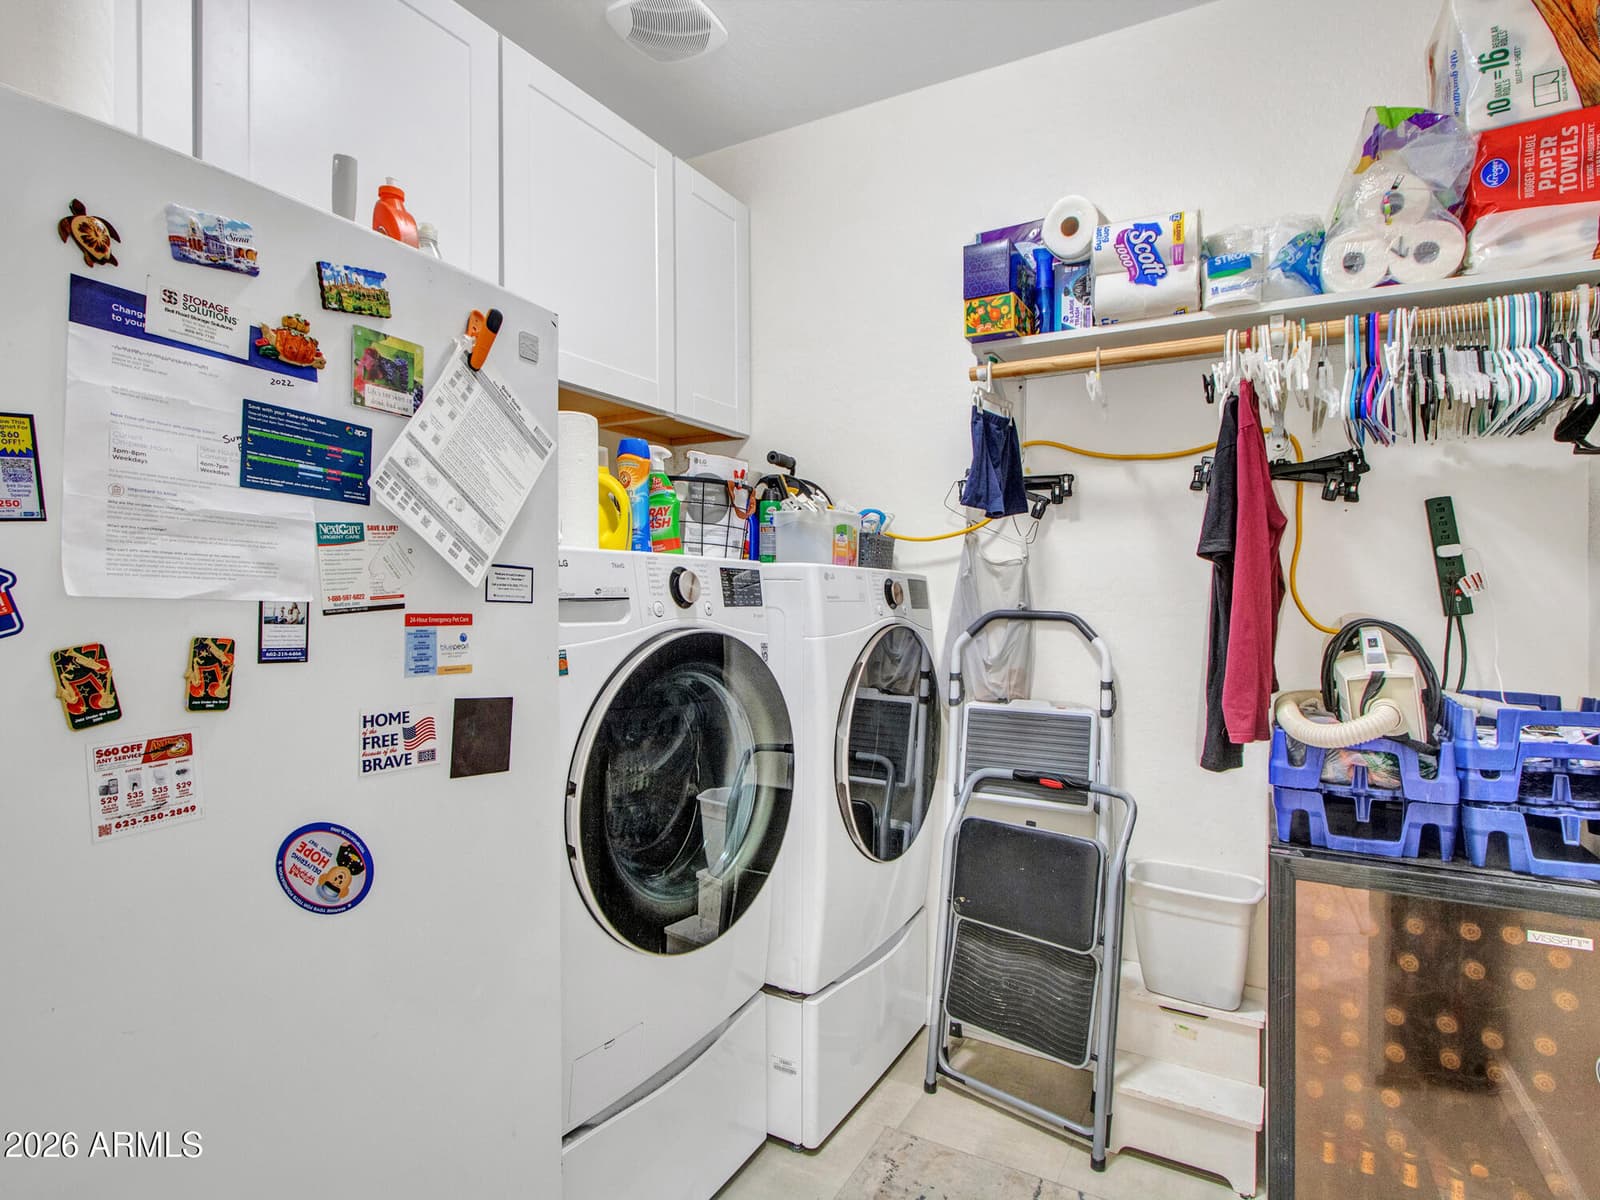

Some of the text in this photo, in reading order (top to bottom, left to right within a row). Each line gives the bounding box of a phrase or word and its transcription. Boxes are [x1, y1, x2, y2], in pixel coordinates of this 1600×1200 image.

[1477, 48, 1510, 74] 16
[1487, 97, 1511, 117] 10
[1524, 134, 1536, 167] RELIABLE
[1538, 135, 1558, 191] PAPER
[1559, 125, 1579, 194] TOWELS
[1487, 161, 1505, 187] Kroger
[225, 231, 250, 244] Siena
[1113, 244, 1134, 267] 1000
[1129, 230, 1168, 277] Scott
[183, 293, 229, 314] STORAGE
[112, 313, 122, 322] to
[183, 303, 237, 325] SOLUTIONS
[270, 378, 295, 388] 2022
[112, 447, 147, 456] 3pm-8pm
[112, 454, 148, 464] Weekdays
[200, 467, 230, 476] Weekdays
[649, 506, 671, 517] RAY
[319, 524, 360, 535] NextCare
[649, 517, 671, 529] ASH
[558, 559, 569, 567] LG
[429, 616, 451, 624] Emergency
[362, 711, 410, 728] HOME
[362, 733, 399, 750] FREE
[96, 743, 143, 758] $60 OFF
[114, 753, 141, 762] SERVICE
[362, 752, 412, 773] BRAVE
[152, 786, 168, 794] $35
[176, 781, 192, 790] $29
[100, 796, 118, 805] $29
[127, 791, 144, 800] $35
[115, 805, 196, 829] 623-250-2849
[295, 841, 330, 868] HOPE
[291, 852, 322, 875] DELIVERING
